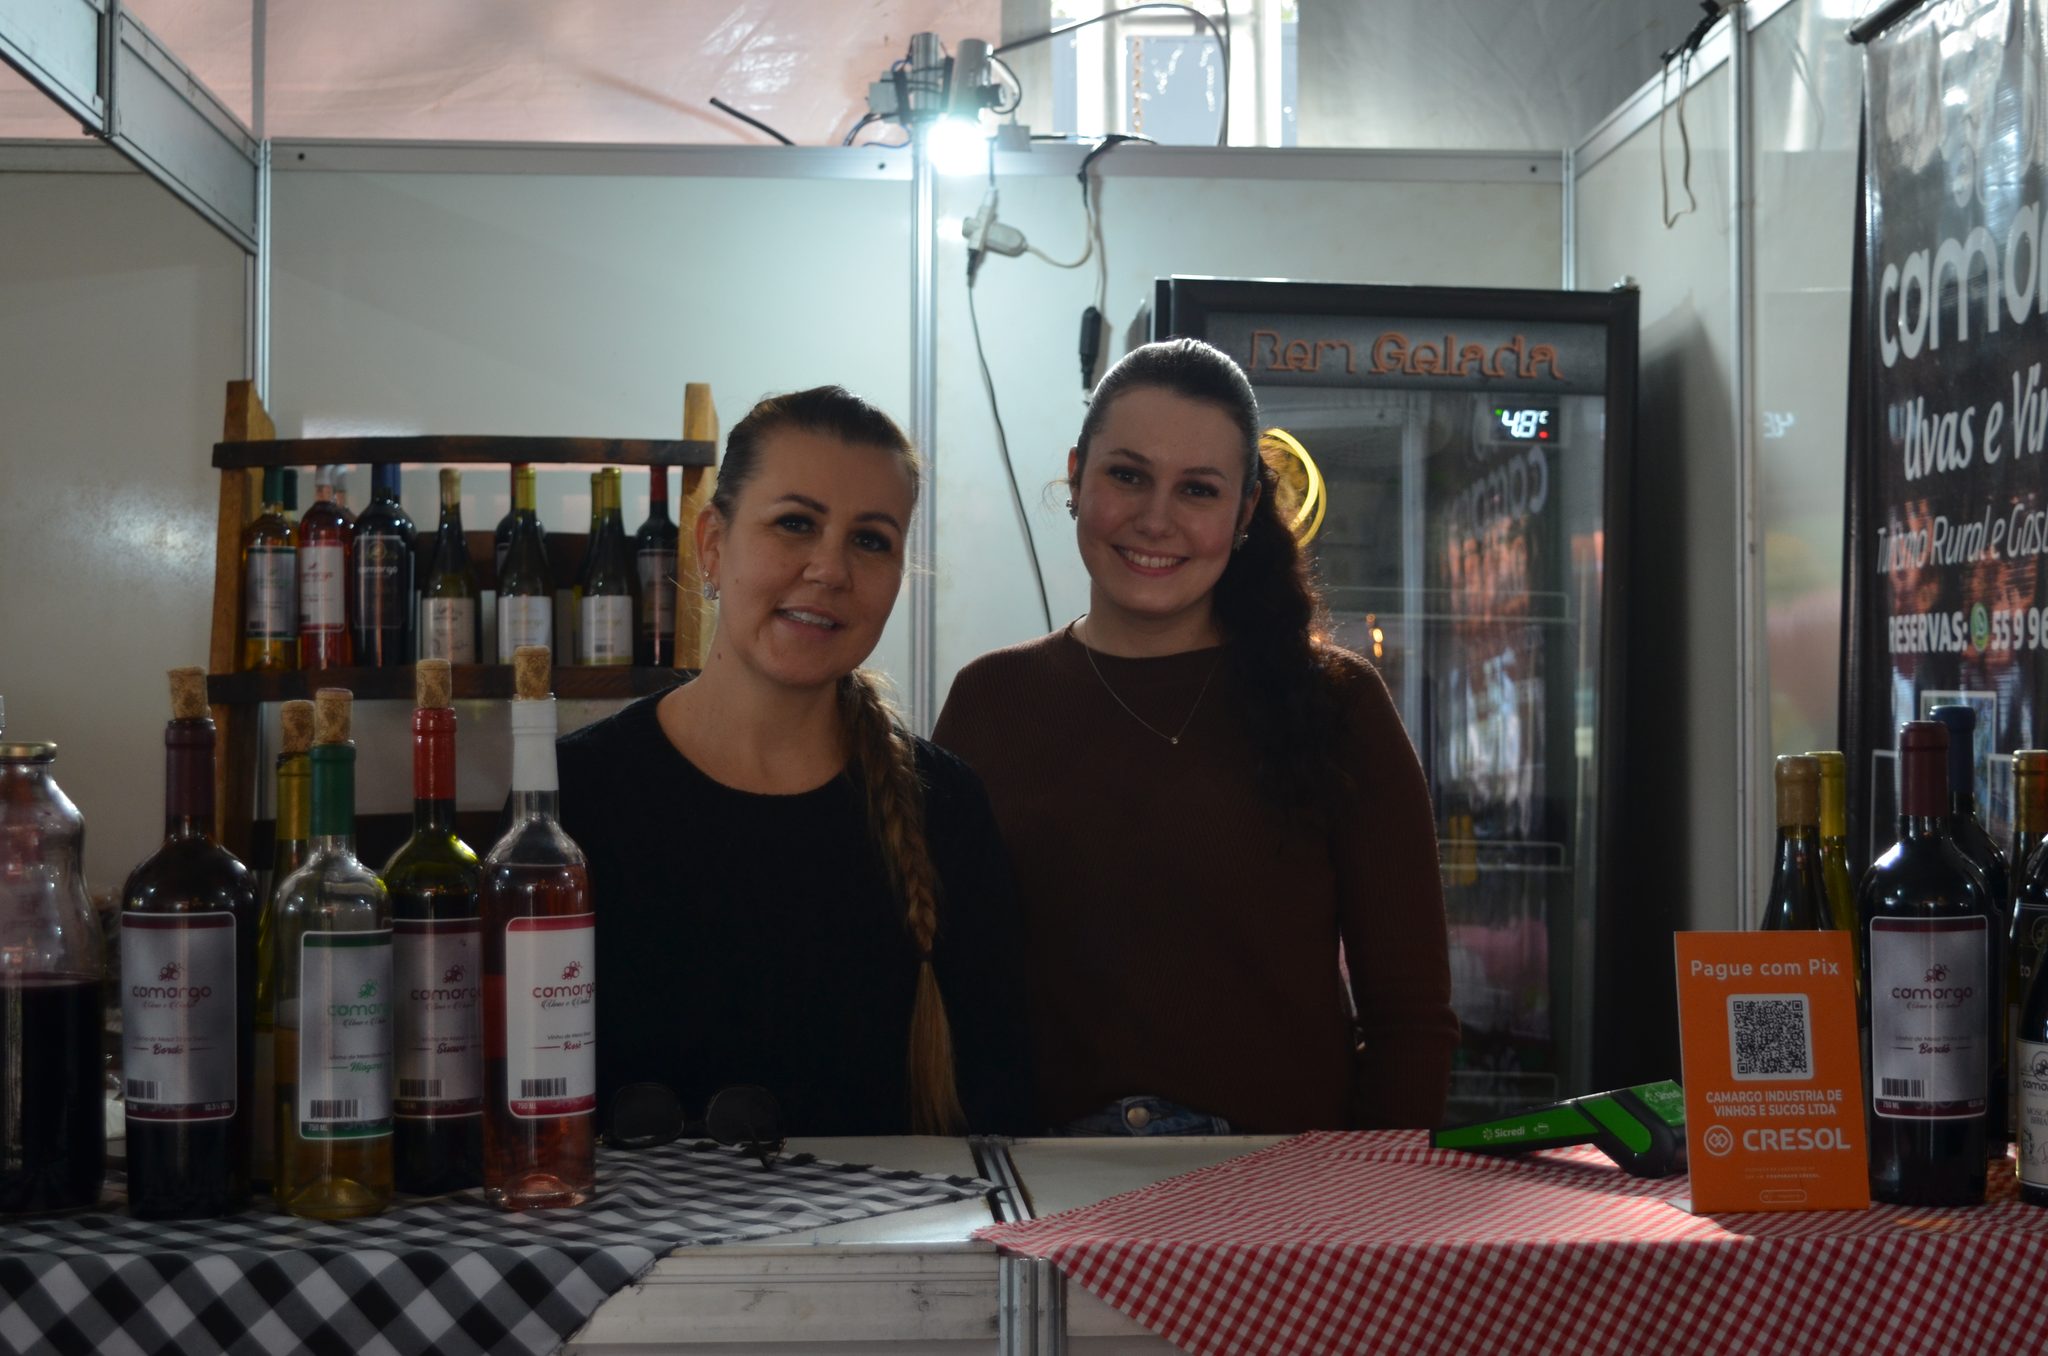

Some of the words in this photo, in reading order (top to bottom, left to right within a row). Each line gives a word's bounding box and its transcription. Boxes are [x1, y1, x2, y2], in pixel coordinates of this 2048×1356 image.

[1368, 330, 1565, 380] Gelada
[1904, 396, 1975, 481] Uvas
[1983, 400, 2003, 464] e
[1930, 504, 1991, 566] Rural
[1990, 517, 2006, 560] e
[1888, 610, 1968, 654] RESERVAS:
[1991, 608, 2011, 651] 55
[2012, 607, 2024, 651] 9
[1690, 959, 1753, 981] Pague
[1760, 962, 1802, 976] com
[1808, 958, 1840, 976] Pix
[132, 986, 212, 1003] camargo
[1892, 986, 1973, 1004] camargo
[1706, 1090, 1762, 1104] CAMARGO
[1765, 1090, 1824, 1102] INDUSTRIA
[1827, 1089, 1842, 1101] DE
[1713, 1105, 1757, 1117] VINHOS
[1759, 1104, 1767, 1116] E
[1768, 1104, 1805, 1116] SUCOS
[1808, 1103, 1837, 1115] LTDA
[1494, 1126, 1525, 1138] Sicredi
[1742, 1127, 1852, 1152] CRESOL
